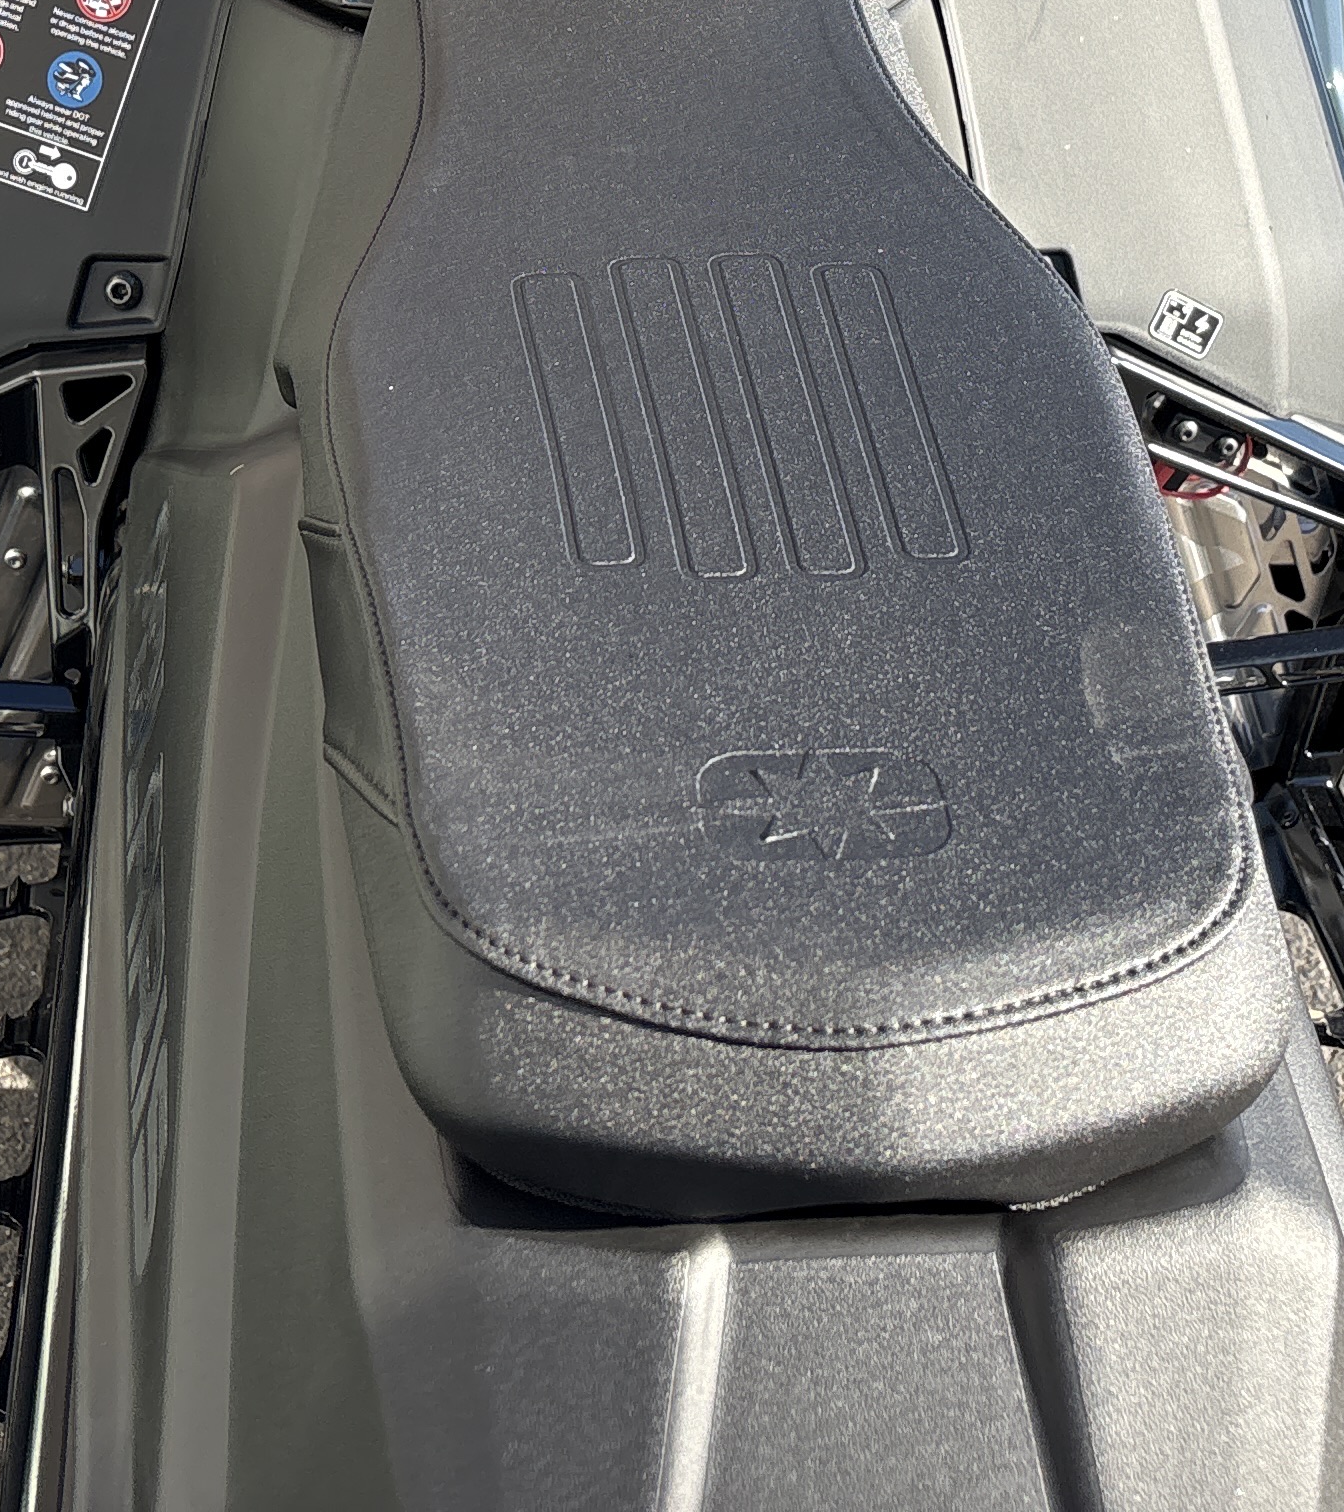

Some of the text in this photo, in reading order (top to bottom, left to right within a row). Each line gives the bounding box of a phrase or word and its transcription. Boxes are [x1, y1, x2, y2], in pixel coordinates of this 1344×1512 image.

[53, 6, 135, 41] Never consume alcohol
[59, 20, 79, 32] drugs
[80, 26, 103, 40] before
[113, 39, 131, 50] while
[27, 95, 90, 122] Always wear DOT
